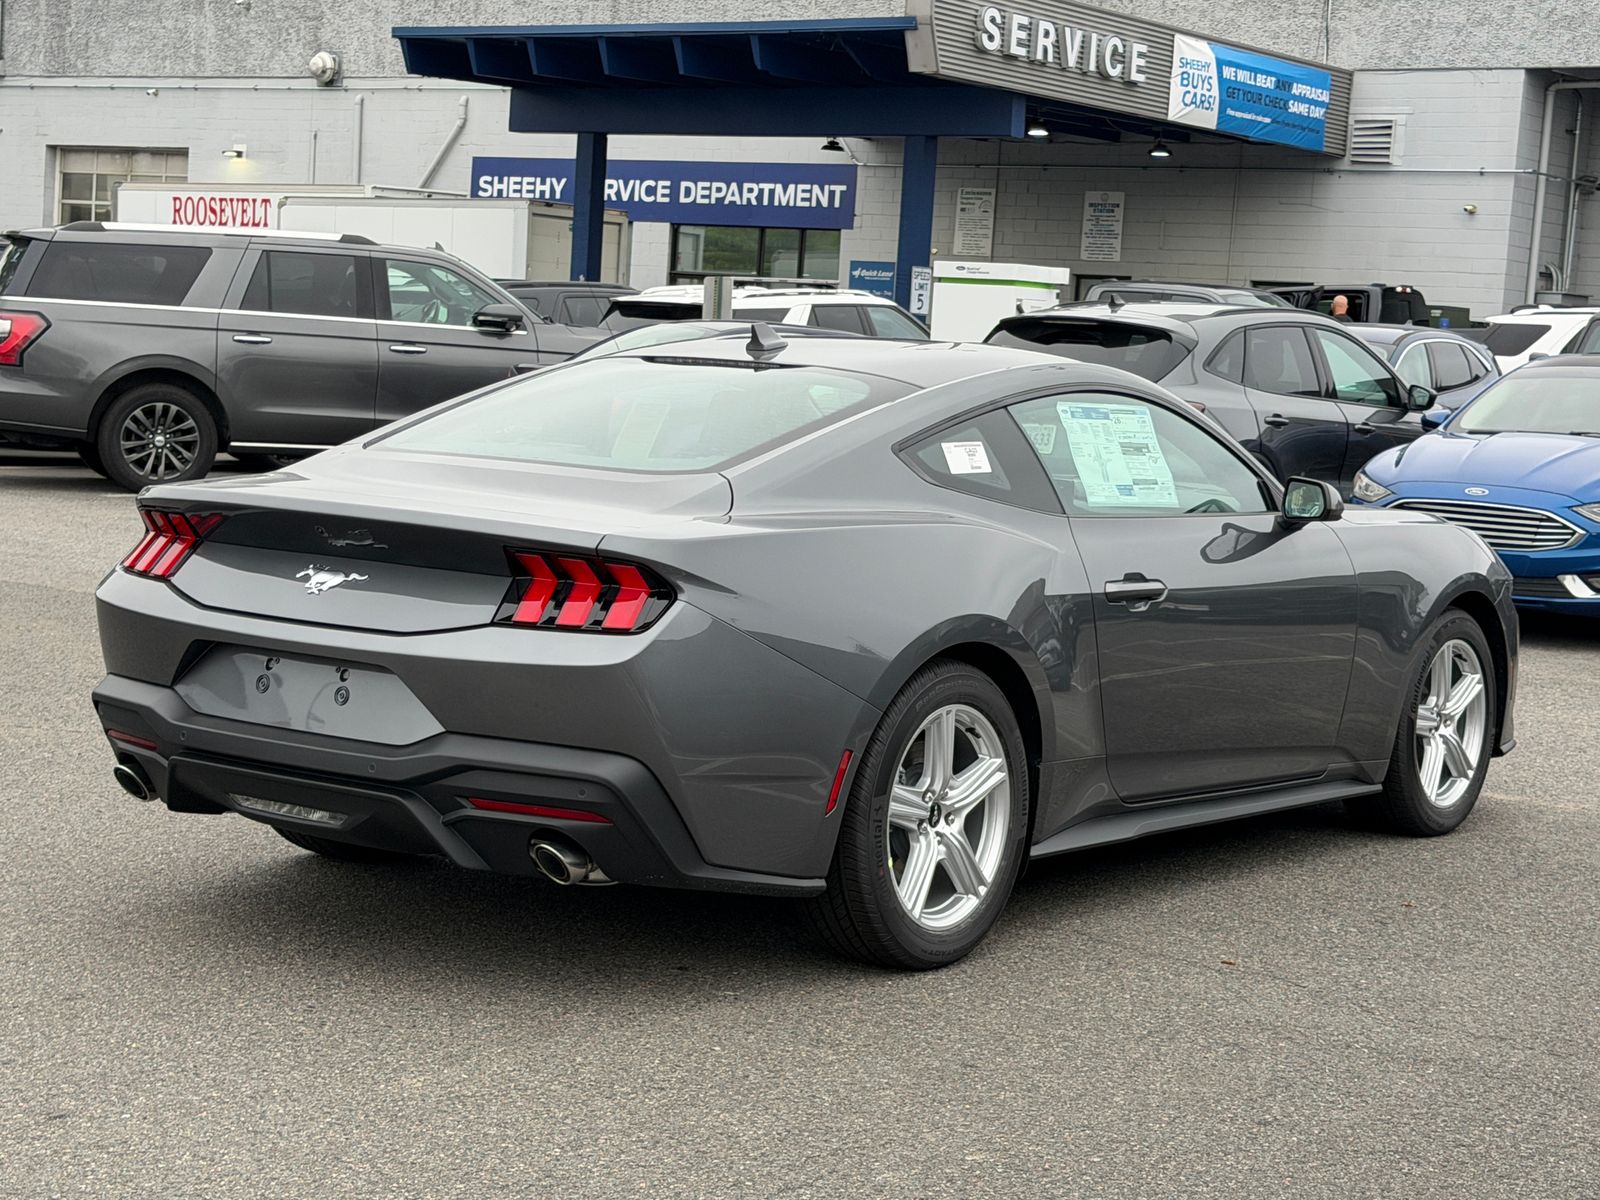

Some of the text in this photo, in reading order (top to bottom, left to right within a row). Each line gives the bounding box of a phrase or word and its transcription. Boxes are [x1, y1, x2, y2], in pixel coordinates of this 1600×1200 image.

[976, 6, 1149, 83] SERVICE
[1179, 56, 1211, 73] SHEEHY
[1180, 71, 1213, 92] BUYS
[1222, 65, 1236, 81] WE
[1237, 69, 1256, 86] WILL
[1256, 73, 1277, 90] BEAT
[1276, 79, 1292, 93] ANY
[1182, 90, 1216, 112] CARS!
[1226, 86, 1241, 101] GET
[1241, 89, 1263, 106] YOUR
[1263, 93, 1288, 111] CHECK
[1288, 99, 1309, 116] SAME
[478, 175, 848, 208] SHEEHY RVICE DEPARTMENT
[172, 196, 271, 227] ROOSEVELT
[913, 270, 931, 281] SPEED
[914, 282, 929, 291] LIMIT
[916, 293, 924, 310] 5
